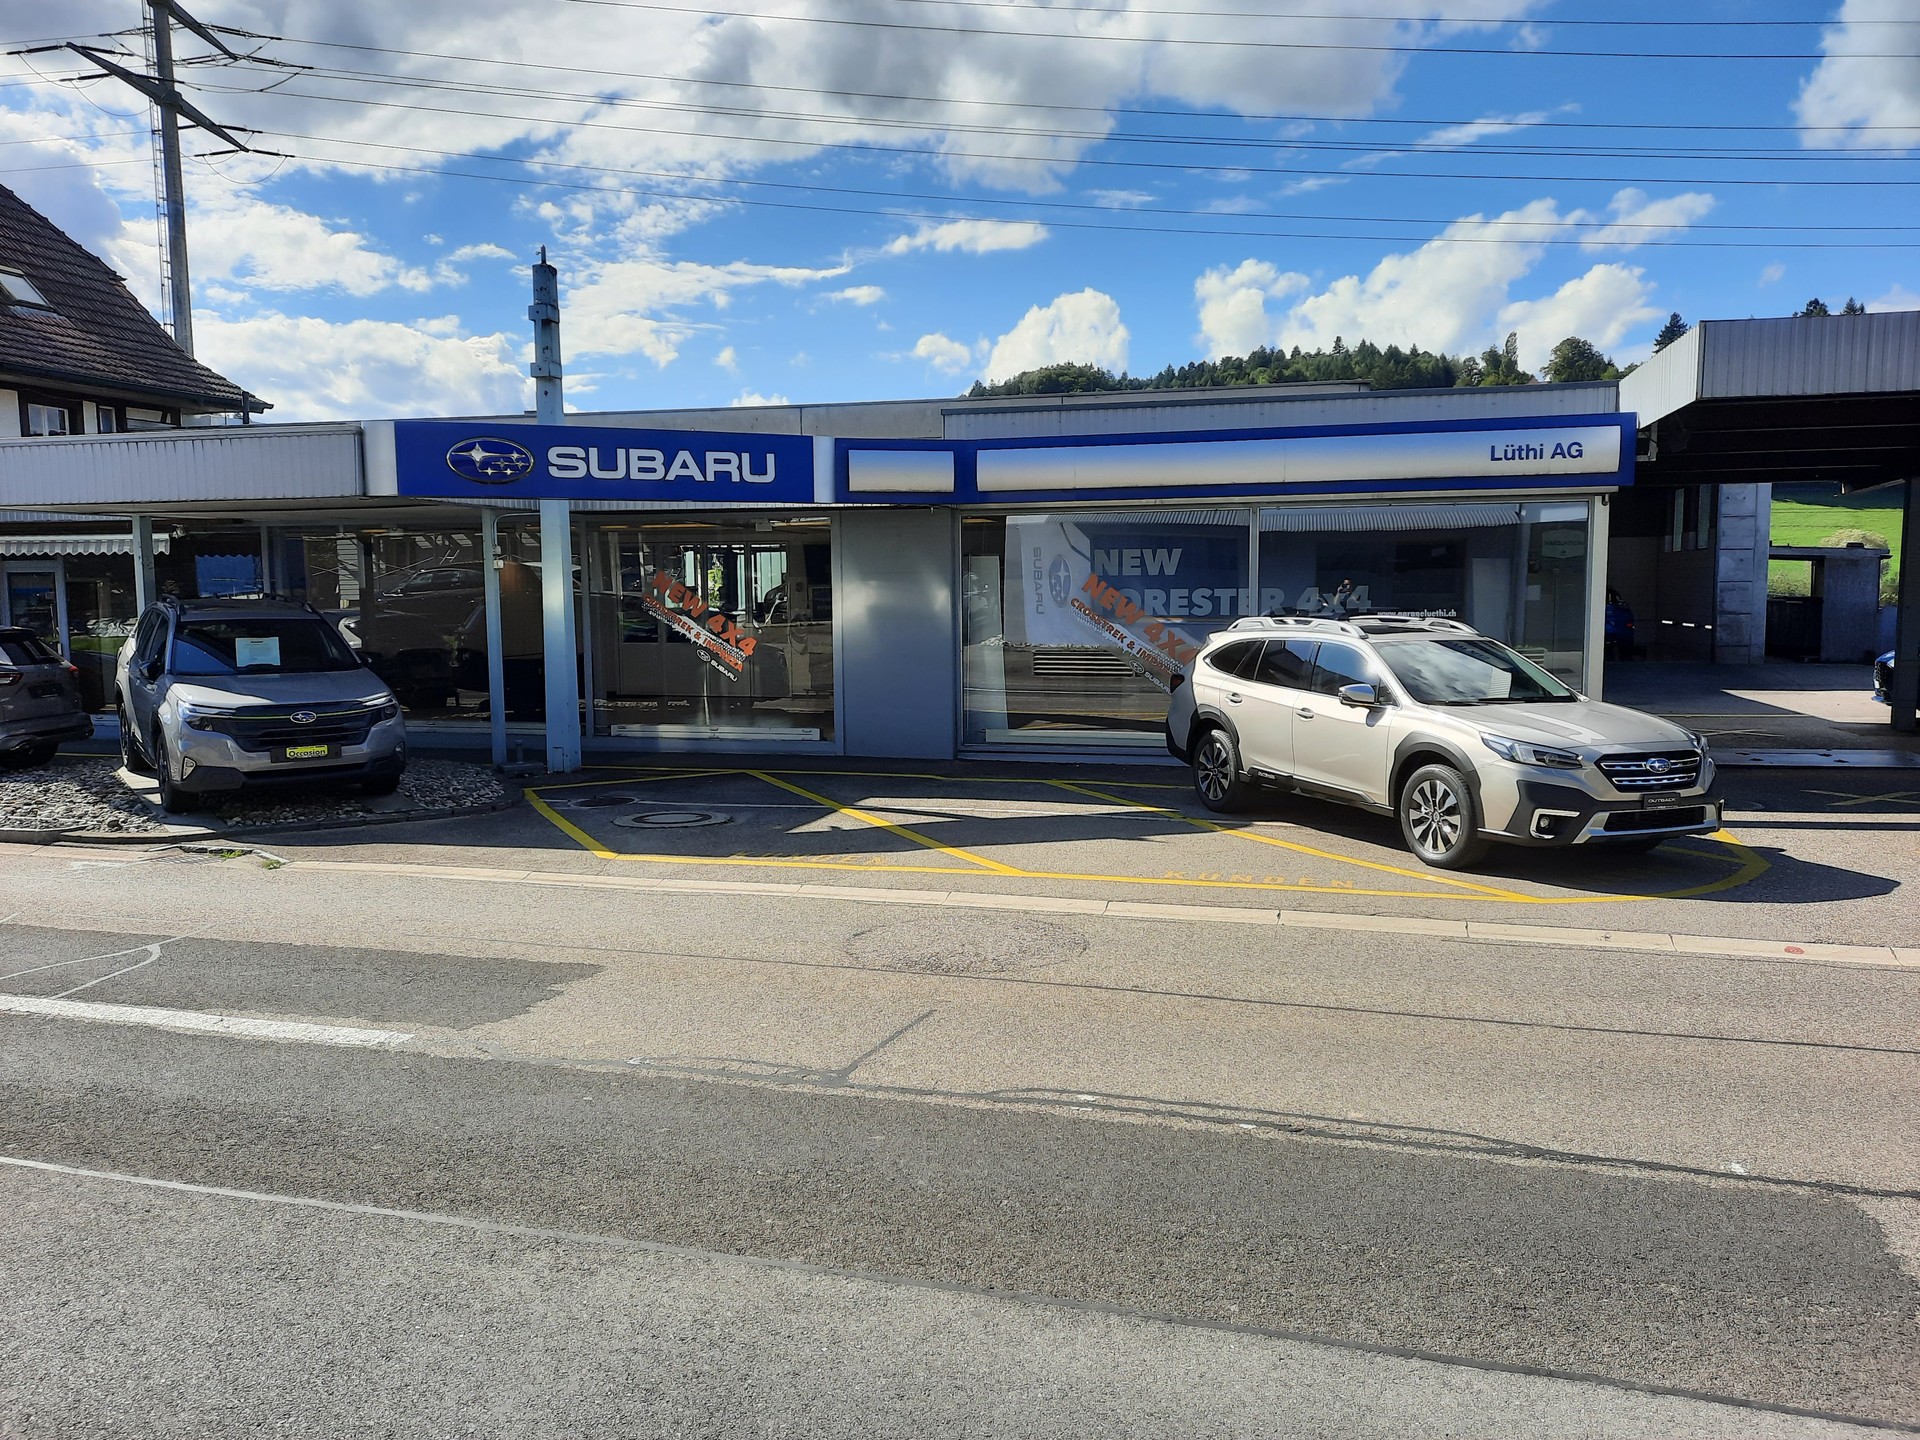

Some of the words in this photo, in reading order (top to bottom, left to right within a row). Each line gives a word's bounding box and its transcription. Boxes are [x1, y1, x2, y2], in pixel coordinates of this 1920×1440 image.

[1490, 443, 1544, 461] Lüthi
[1550, 441, 1584, 459] AG
[547, 446, 776, 483] SUBARU
[1094, 548, 1182, 576] NEW
[1033, 546, 1045, 615] SUBARU
[1081, 571, 1146, 626] NEW
[1096, 587, 1286, 617] ORESTER
[651, 569, 708, 618] NEW
[706, 614, 757, 656] 4X4
[693, 630, 703, 641] &
[1126, 640, 1136, 651] &
[710, 659, 738, 682] SUBARU
[289, 750, 326, 758] Occasion
[1163, 870, 1354, 889] KUNDEN
